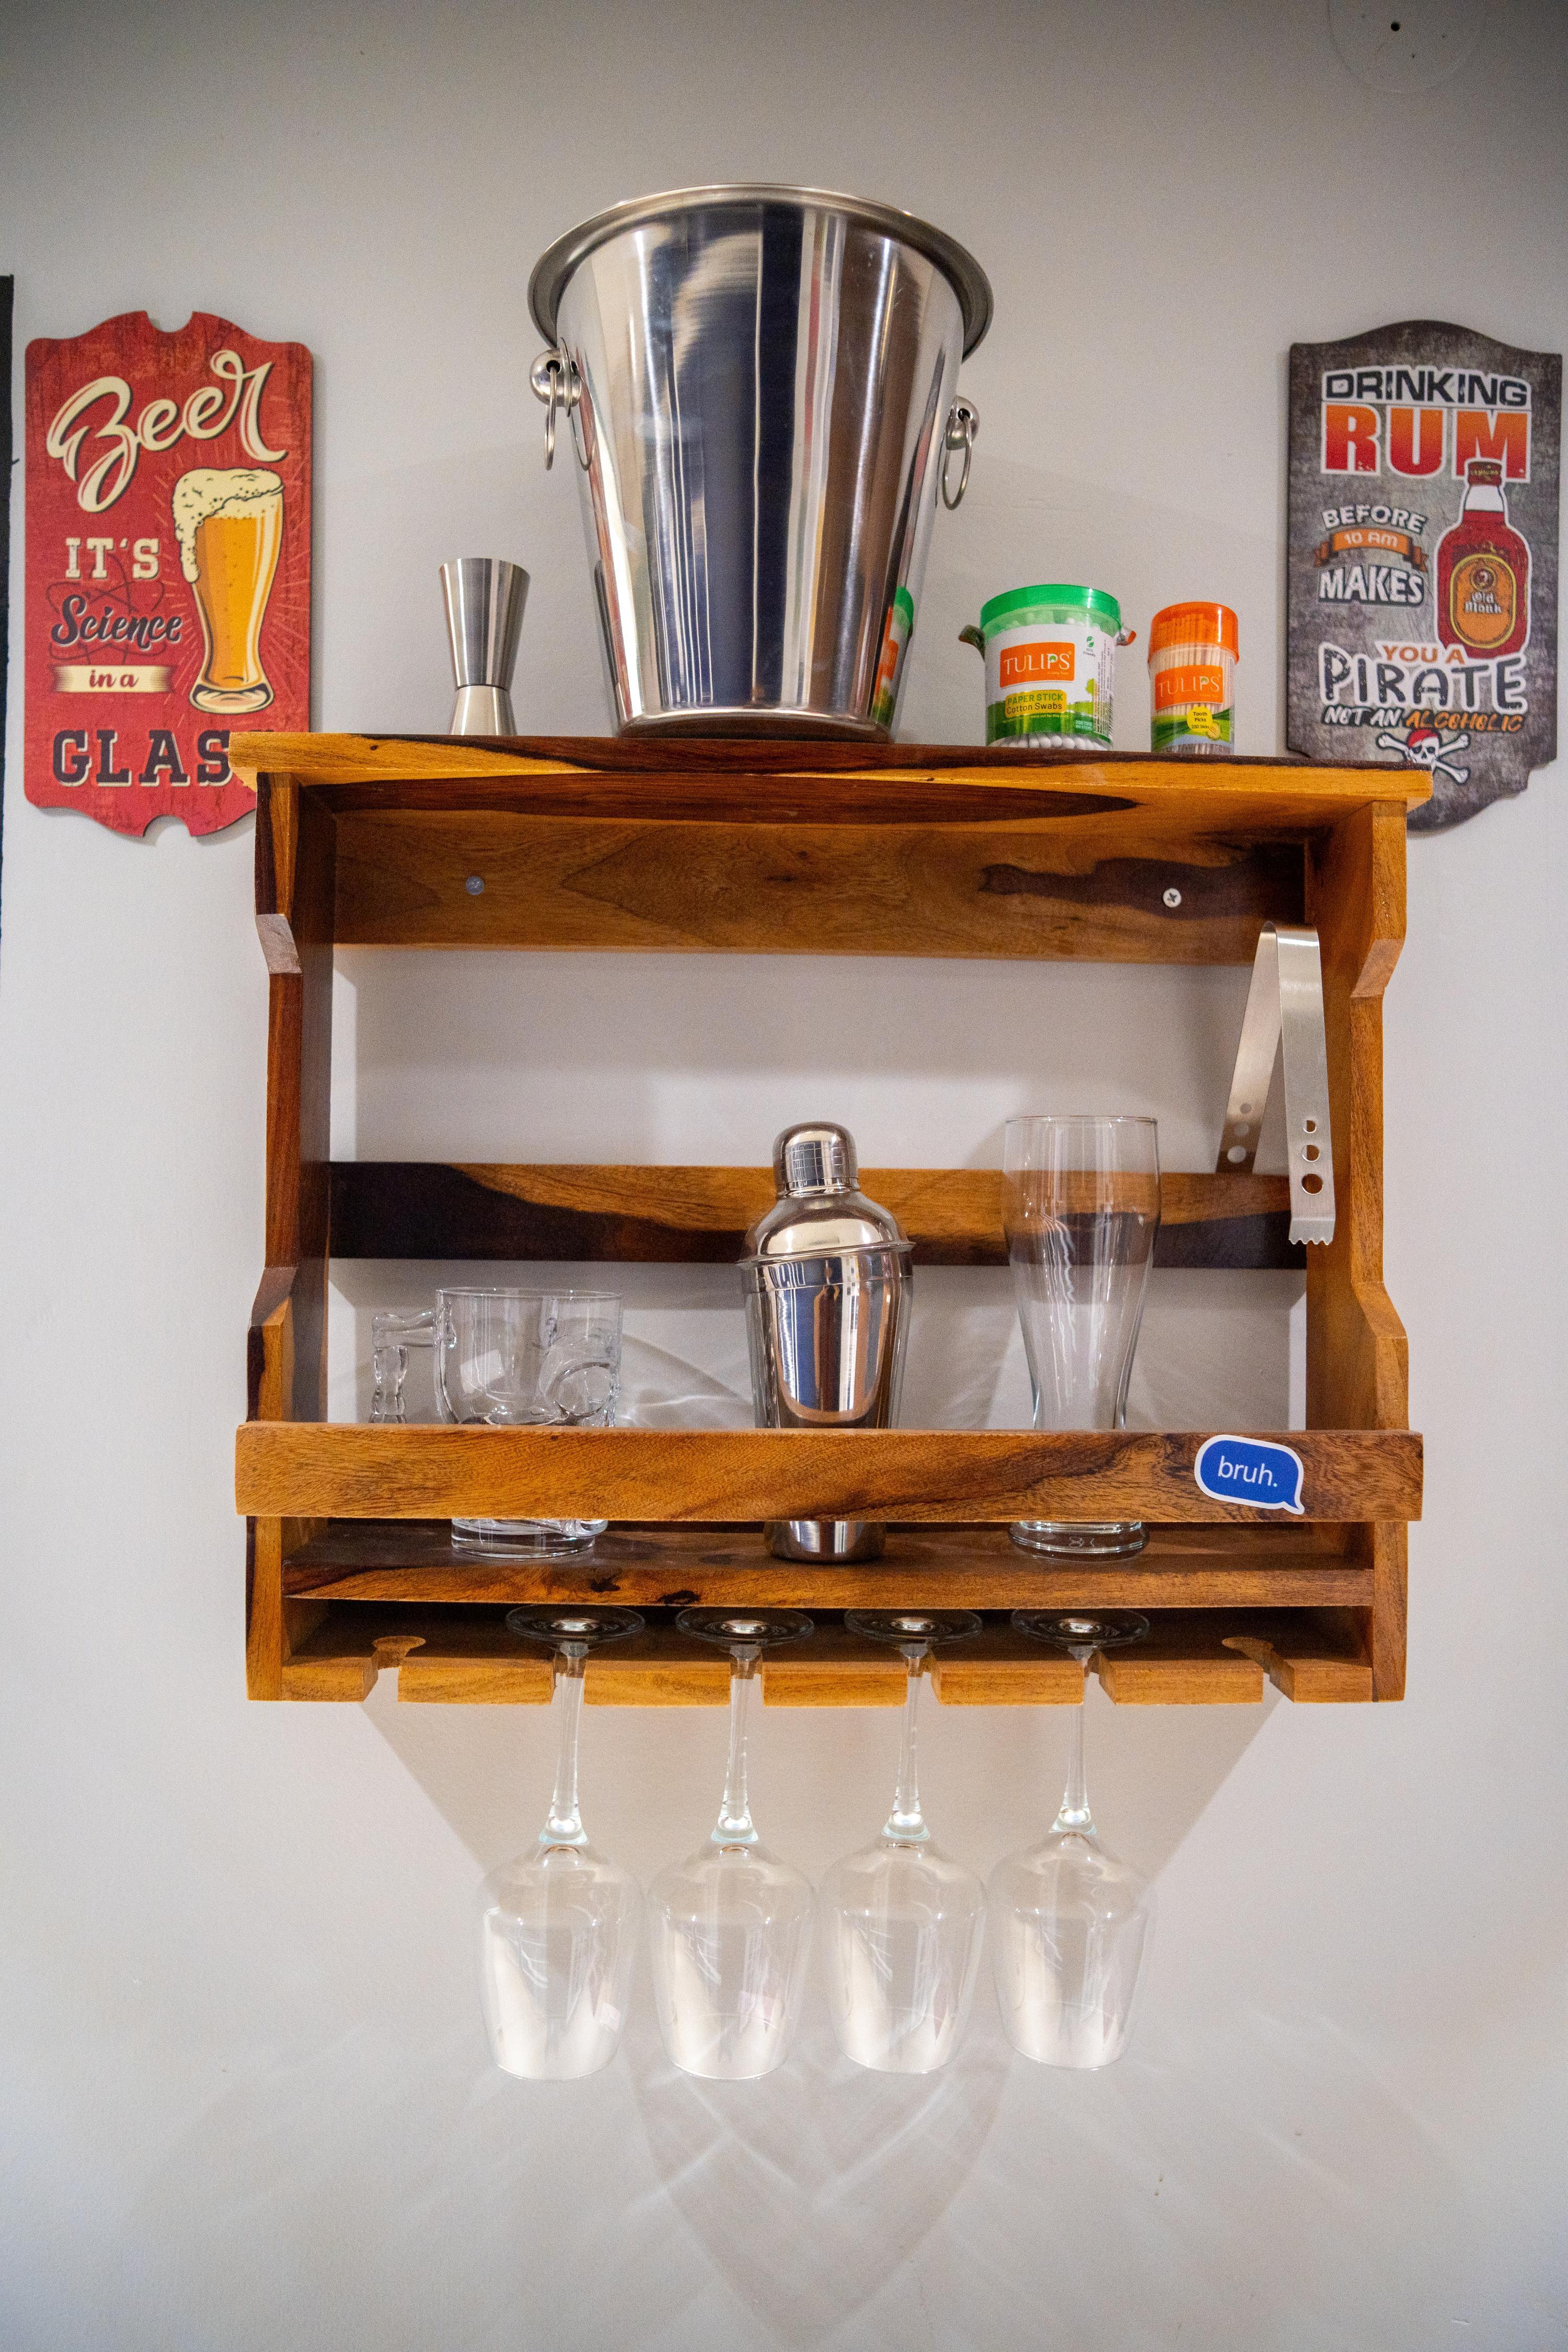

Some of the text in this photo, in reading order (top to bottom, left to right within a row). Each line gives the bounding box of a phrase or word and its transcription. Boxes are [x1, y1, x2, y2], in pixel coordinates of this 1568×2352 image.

[1325, 370, 1528, 407] DRINKING
[47, 349, 289, 513] Beer
[1325, 404, 1529, 479] RUM
[1322, 505, 1428, 534] BEFORE
[1344, 532, 1363, 544] 10
[65, 537, 159, 579] IT'S
[1319, 566, 1428, 604] MAKES
[1472, 591, 1494, 603] Old
[51, 595, 183, 652] Science
[1004, 653, 1070, 675] TULIPS
[1382, 645, 1465, 664] YOU A
[89, 670, 139, 688] in a
[1157, 676, 1220, 698] TULIPS
[1323, 648, 1523, 710] PIRATE
[1007, 693, 1063, 705] PAPER STICK
[1007, 703, 1033, 714] Cotton
[1324, 706, 1523, 731] NOT AN ALCOHOLIC
[53, 730, 274, 787] GLAS
[1217, 1455, 1278, 1488] bruh.
